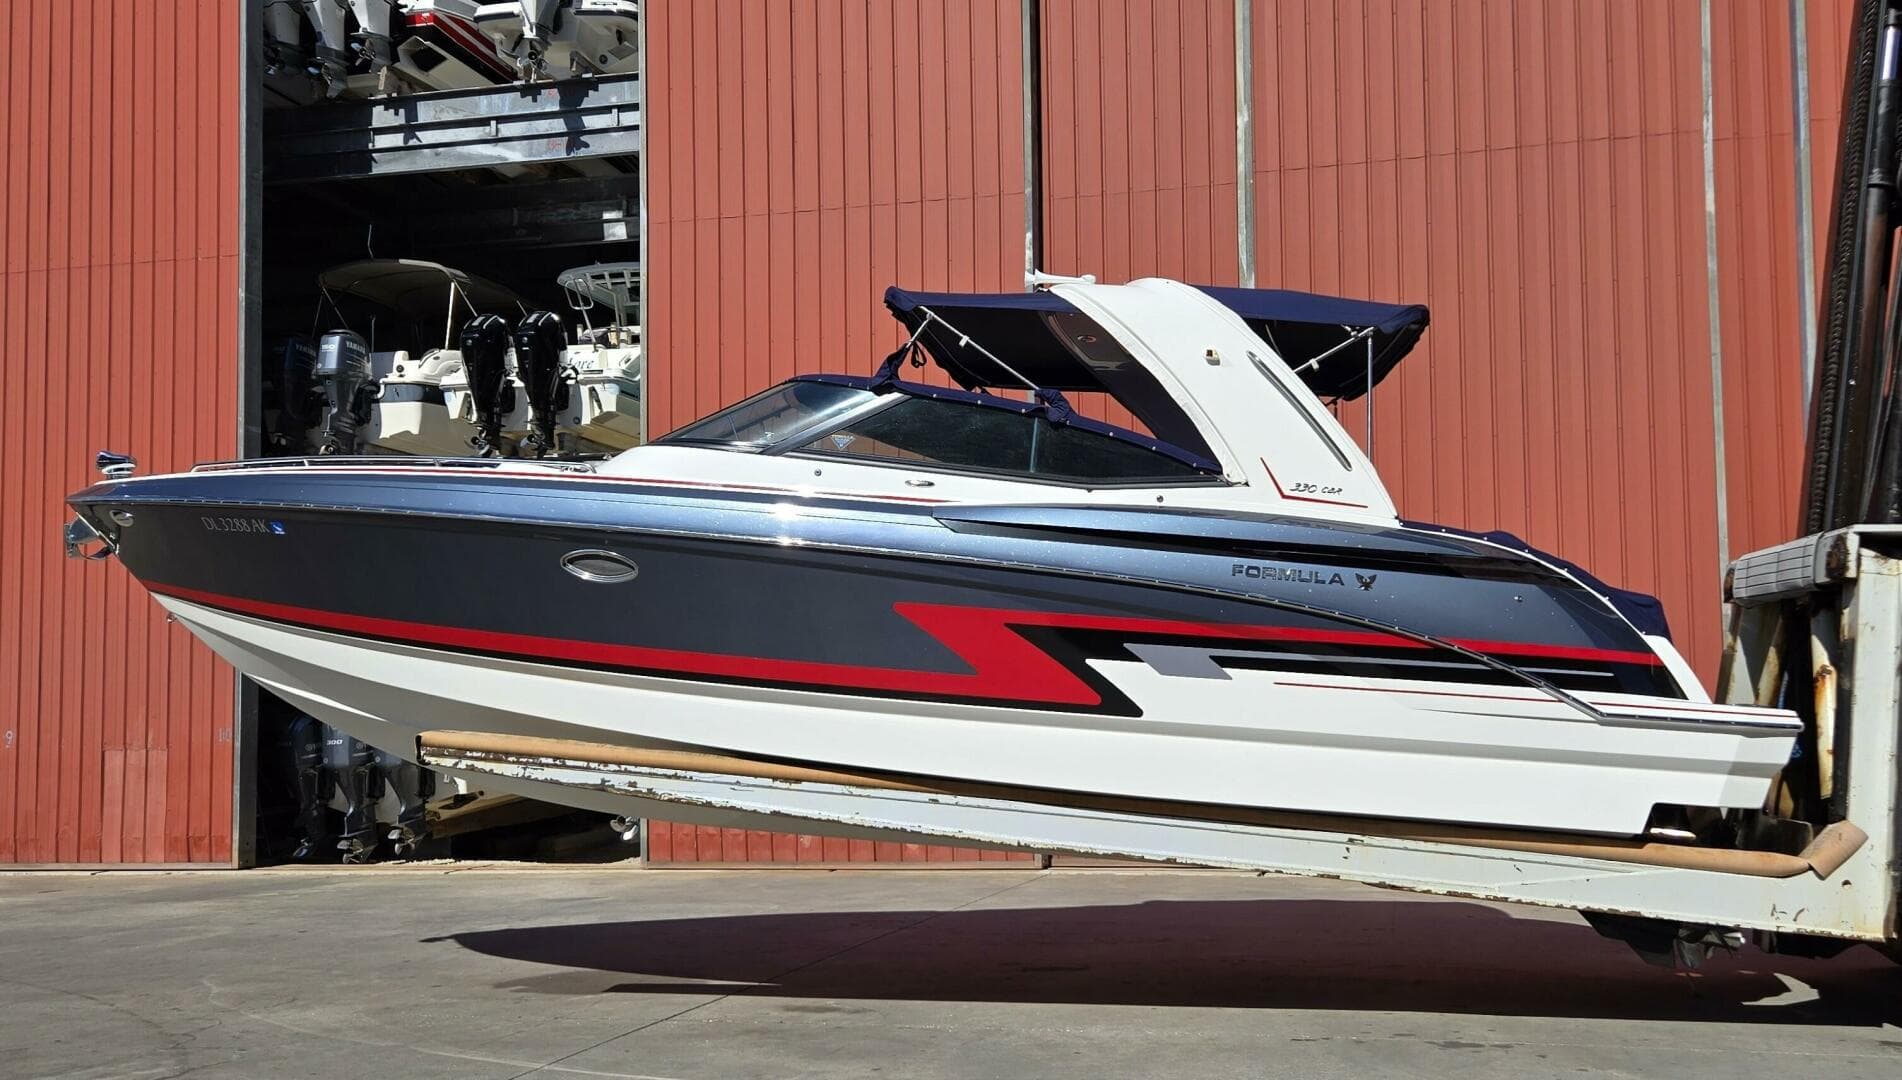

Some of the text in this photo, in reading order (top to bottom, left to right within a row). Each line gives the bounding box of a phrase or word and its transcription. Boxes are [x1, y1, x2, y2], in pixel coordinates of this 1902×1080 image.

[1289, 482, 1318, 494] 330
[201, 516, 270, 534] DL 3288 AK
[1231, 564, 1345, 586] FORMULA
